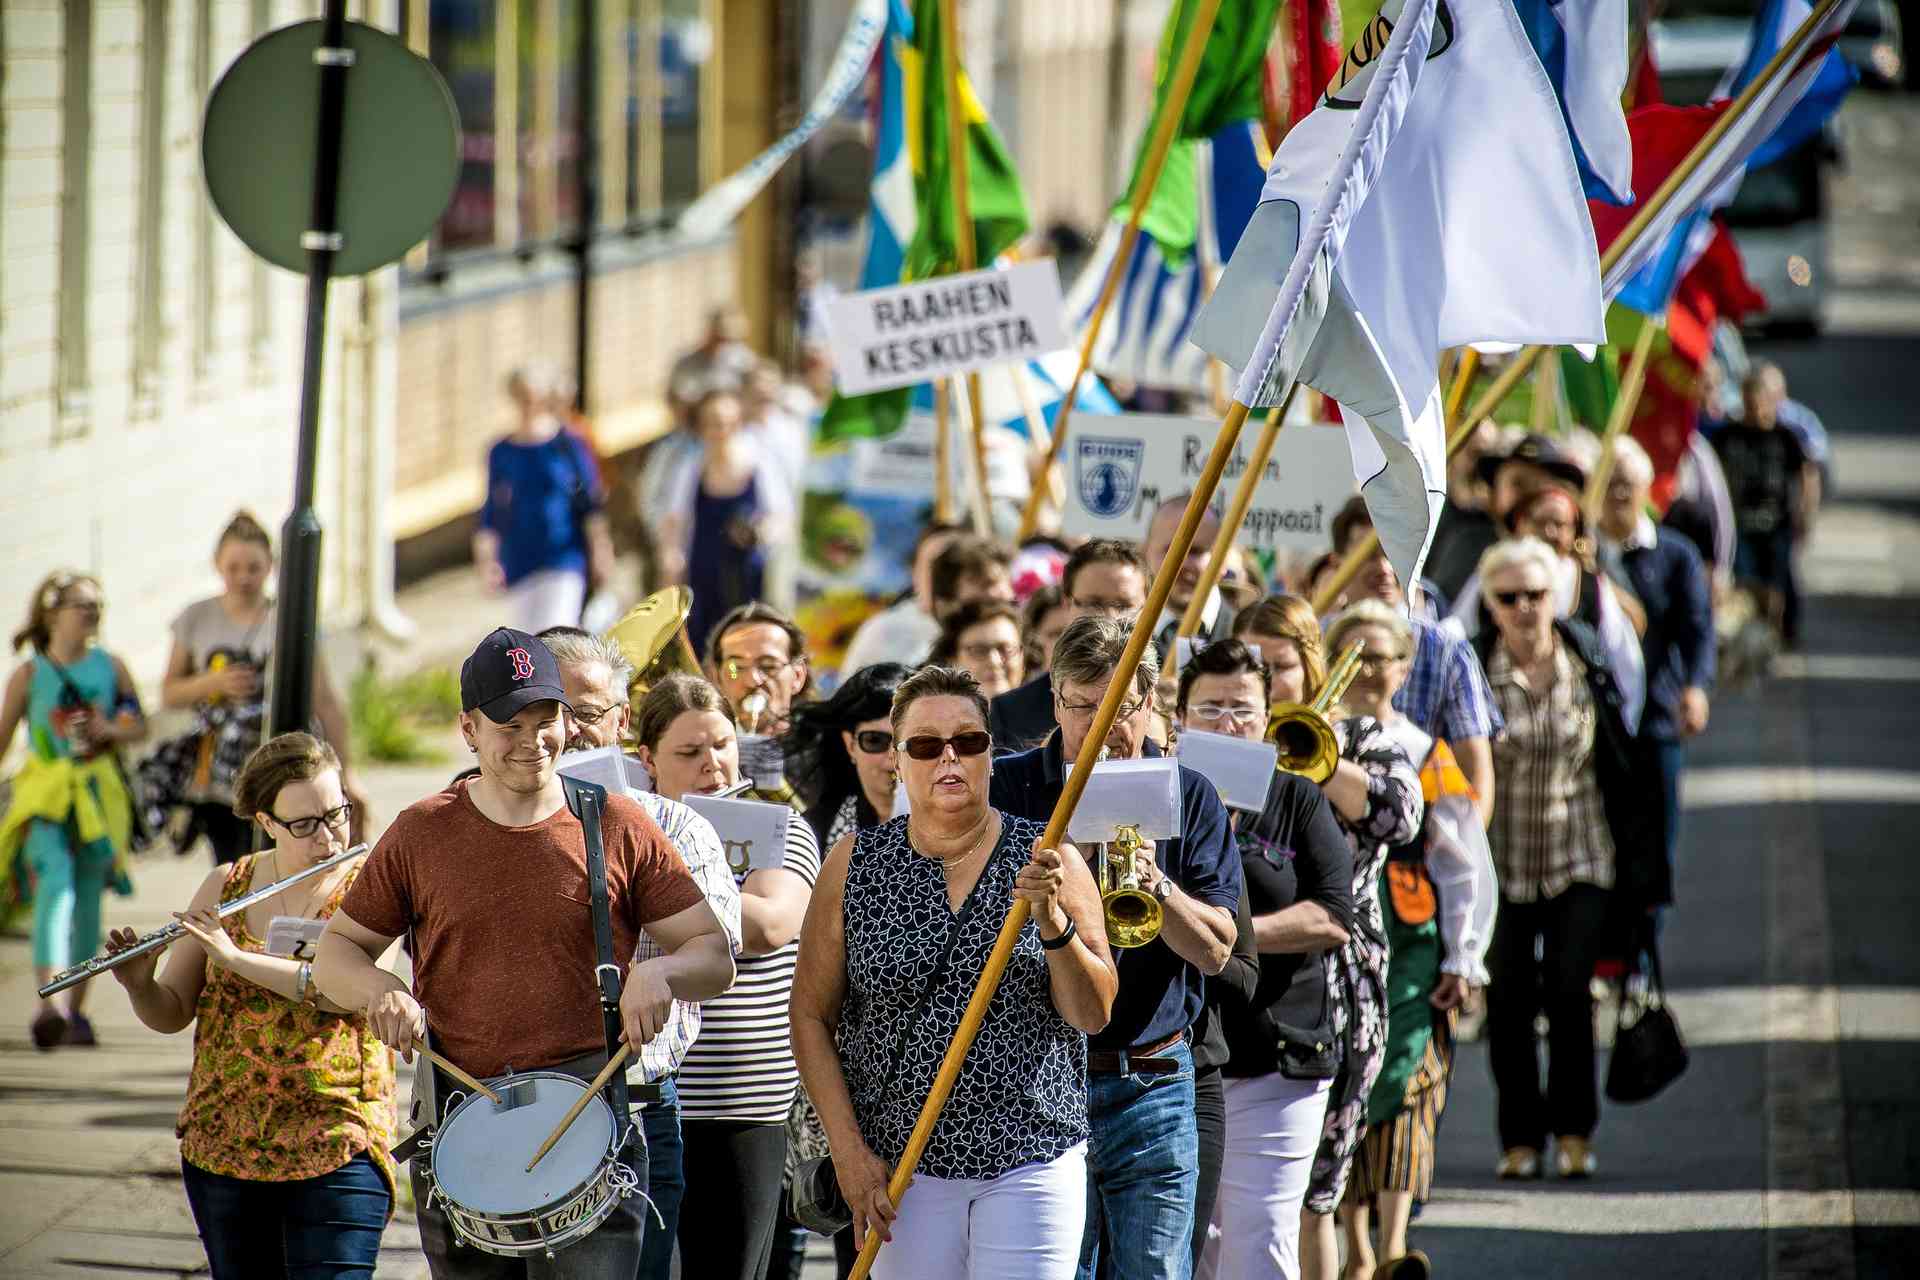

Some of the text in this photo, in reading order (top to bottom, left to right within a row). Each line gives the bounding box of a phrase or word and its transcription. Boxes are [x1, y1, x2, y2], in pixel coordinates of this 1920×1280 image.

[873, 277, 1011, 331] RAAHEN
[863, 316, 1038, 375] KESKUSTA
[506, 647, 535, 681] B
